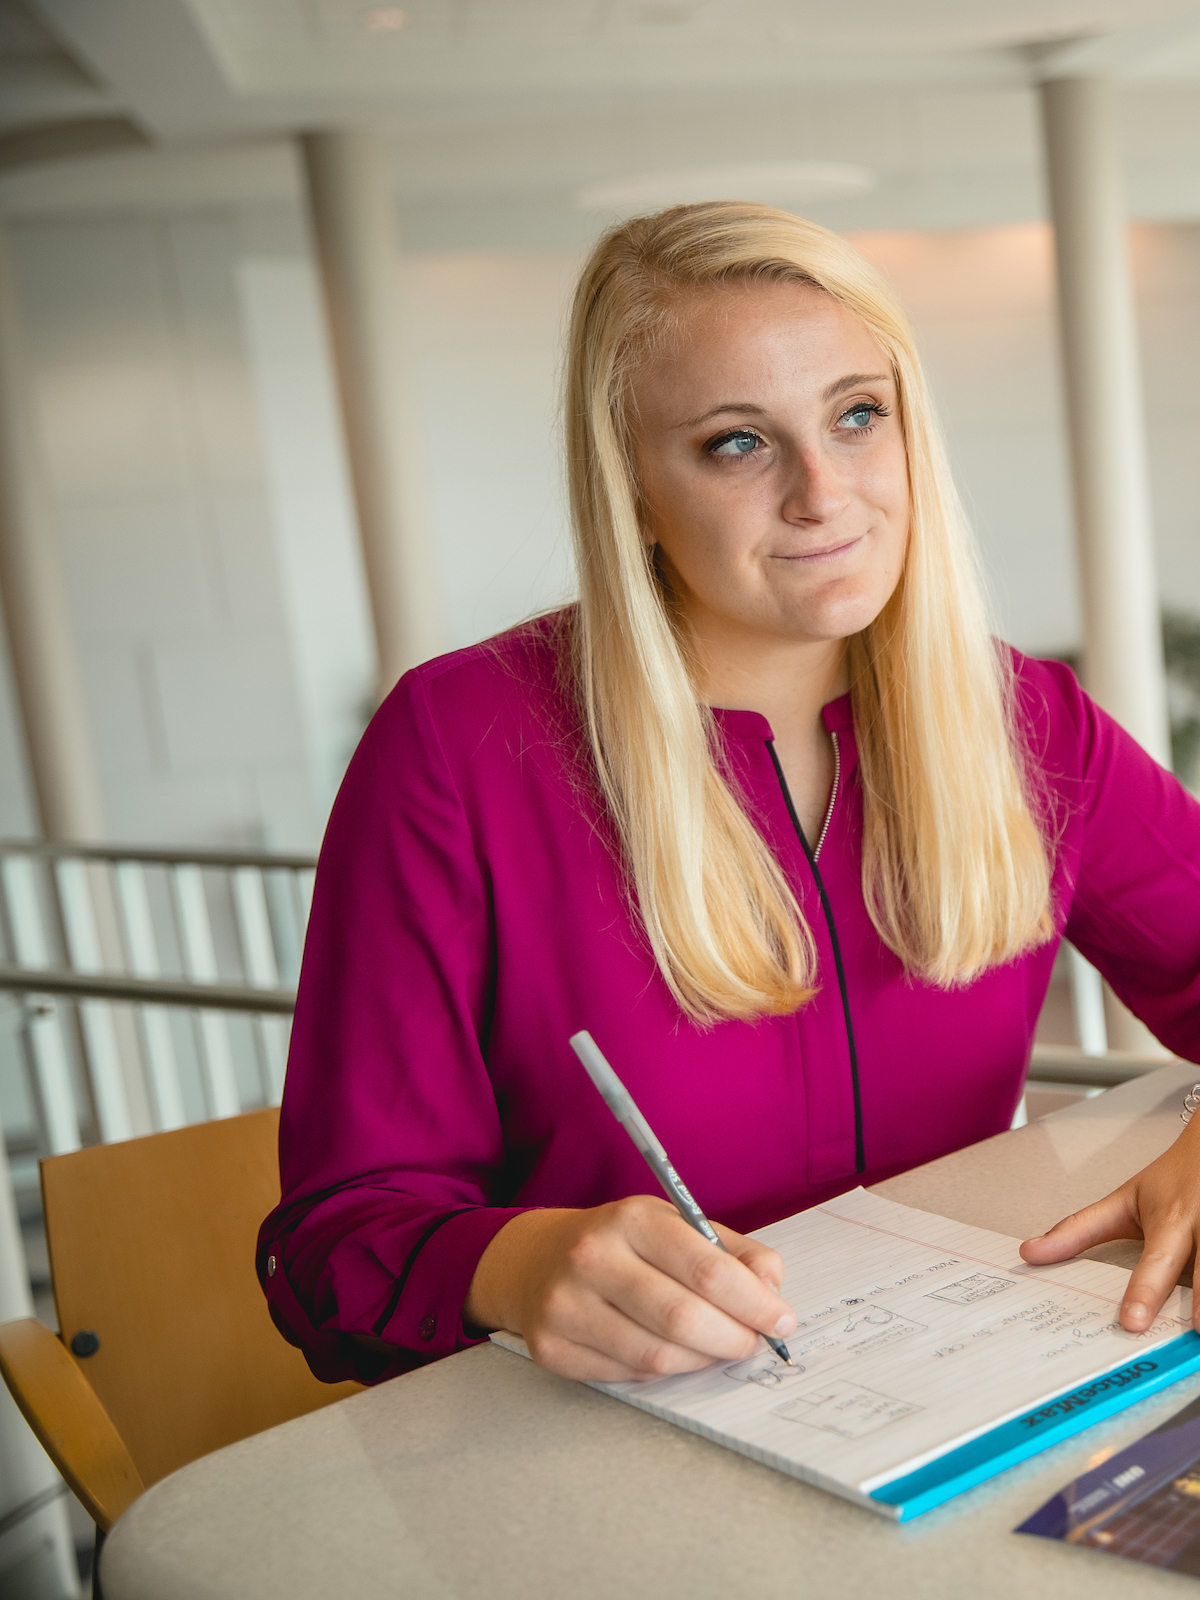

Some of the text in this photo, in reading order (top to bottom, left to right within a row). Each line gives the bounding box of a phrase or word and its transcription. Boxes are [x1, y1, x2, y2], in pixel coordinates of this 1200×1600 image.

[666, 1166, 718, 1239] BIC Round Stic
[1019, 1361, 1159, 1430] OfficeMax
